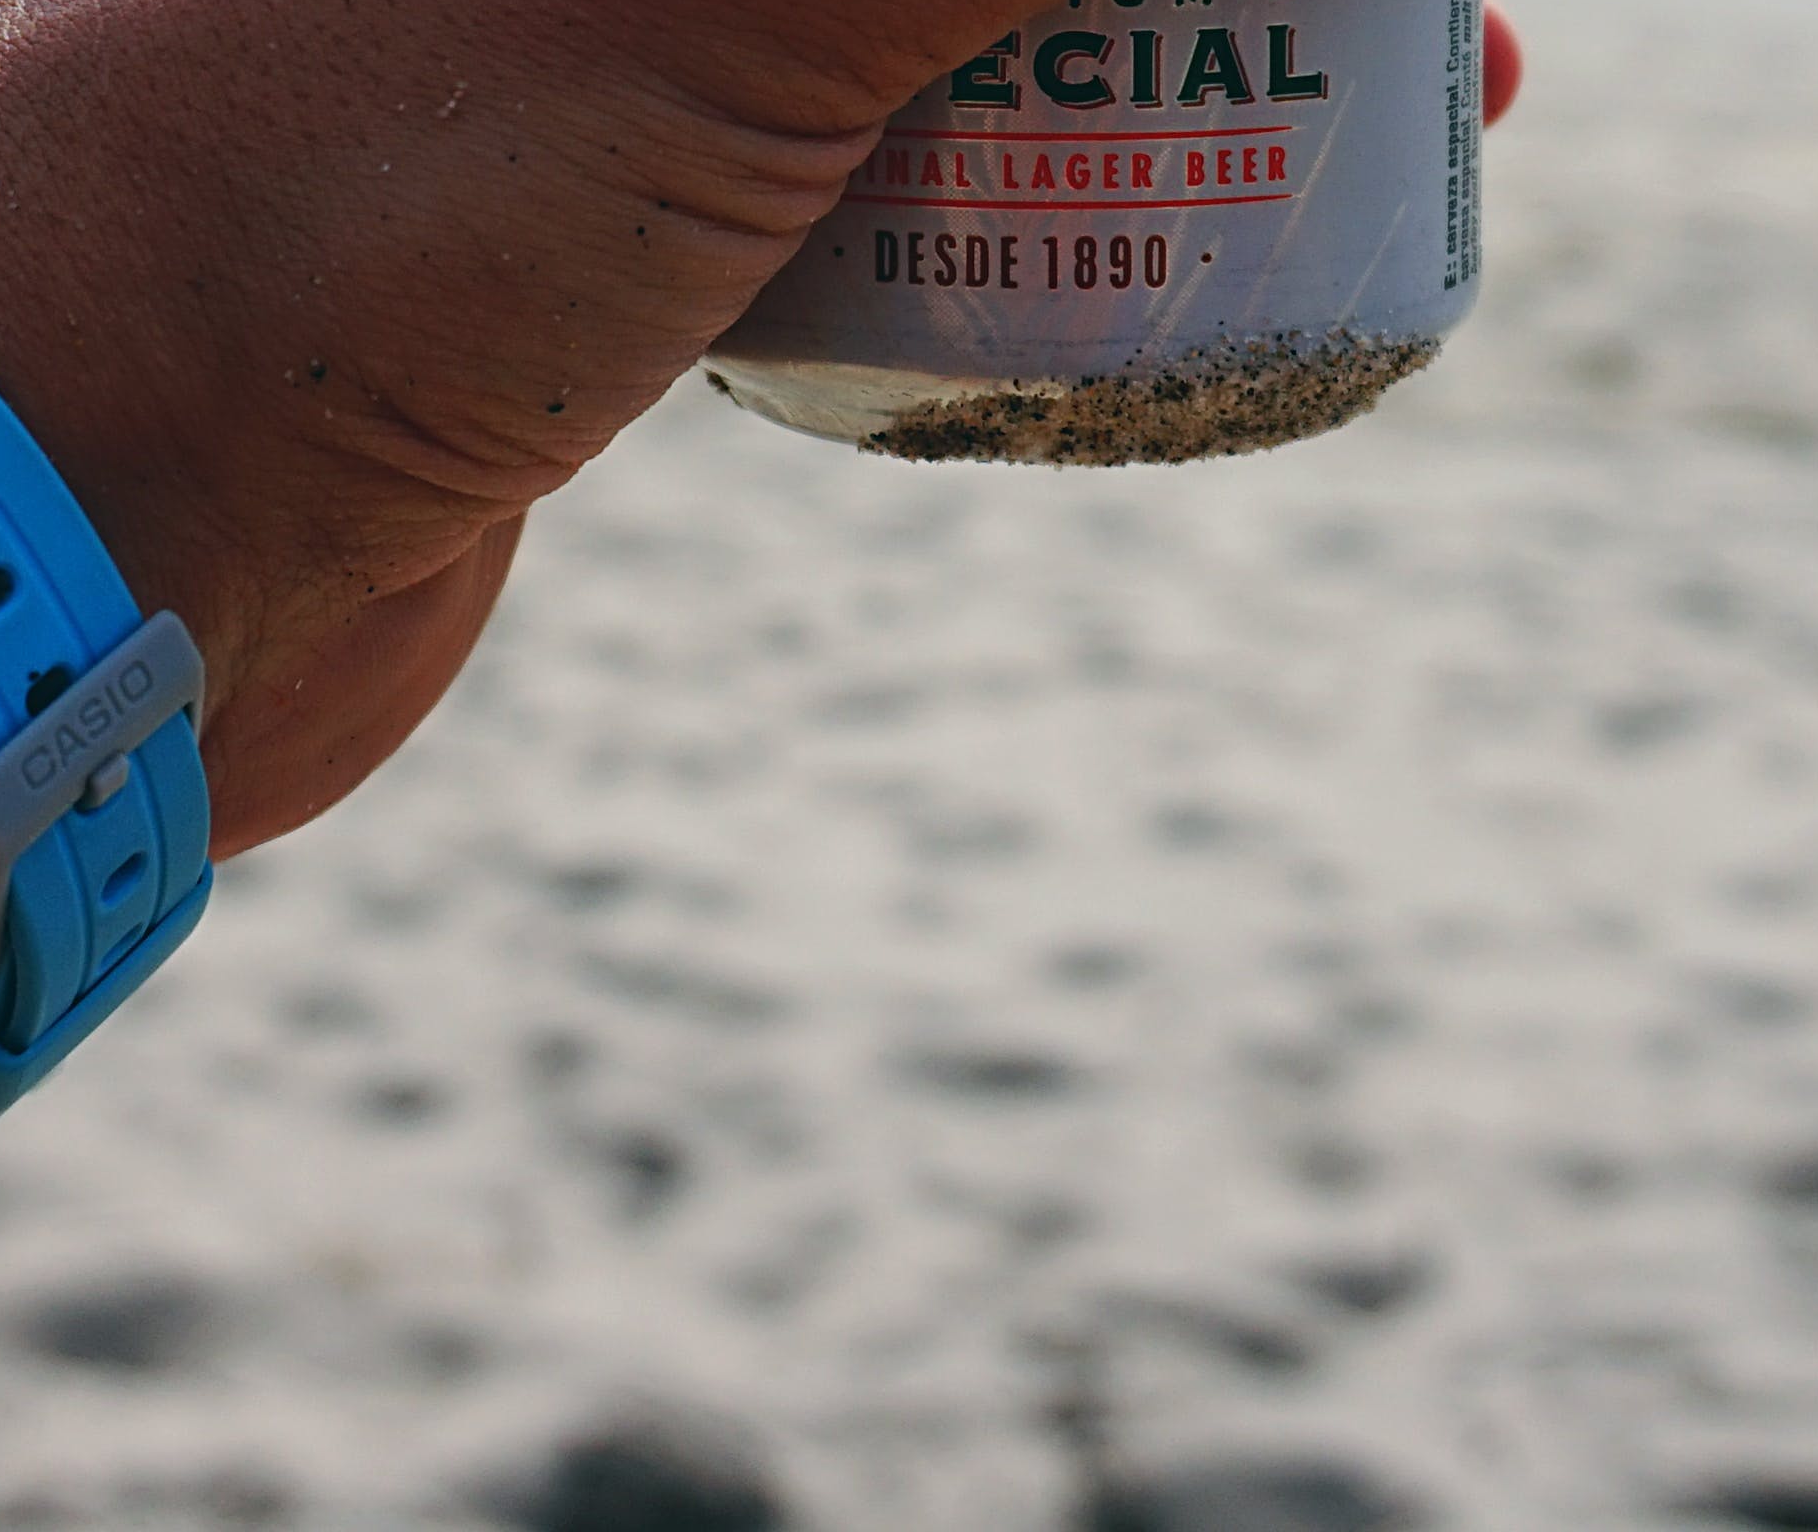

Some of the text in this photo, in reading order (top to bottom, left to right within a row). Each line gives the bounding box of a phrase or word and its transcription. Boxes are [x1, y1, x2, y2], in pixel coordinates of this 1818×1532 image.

[916, 24, 1329, 112] ECIAL
[1001, 147, 1154, 189] LAGER
[1186, 145, 1288, 188] BEER
[1445, 174, 1458, 255] cerveza
[874, 229, 1169, 290] DESDE 1890
[21, 660, 153, 790] CASIO
